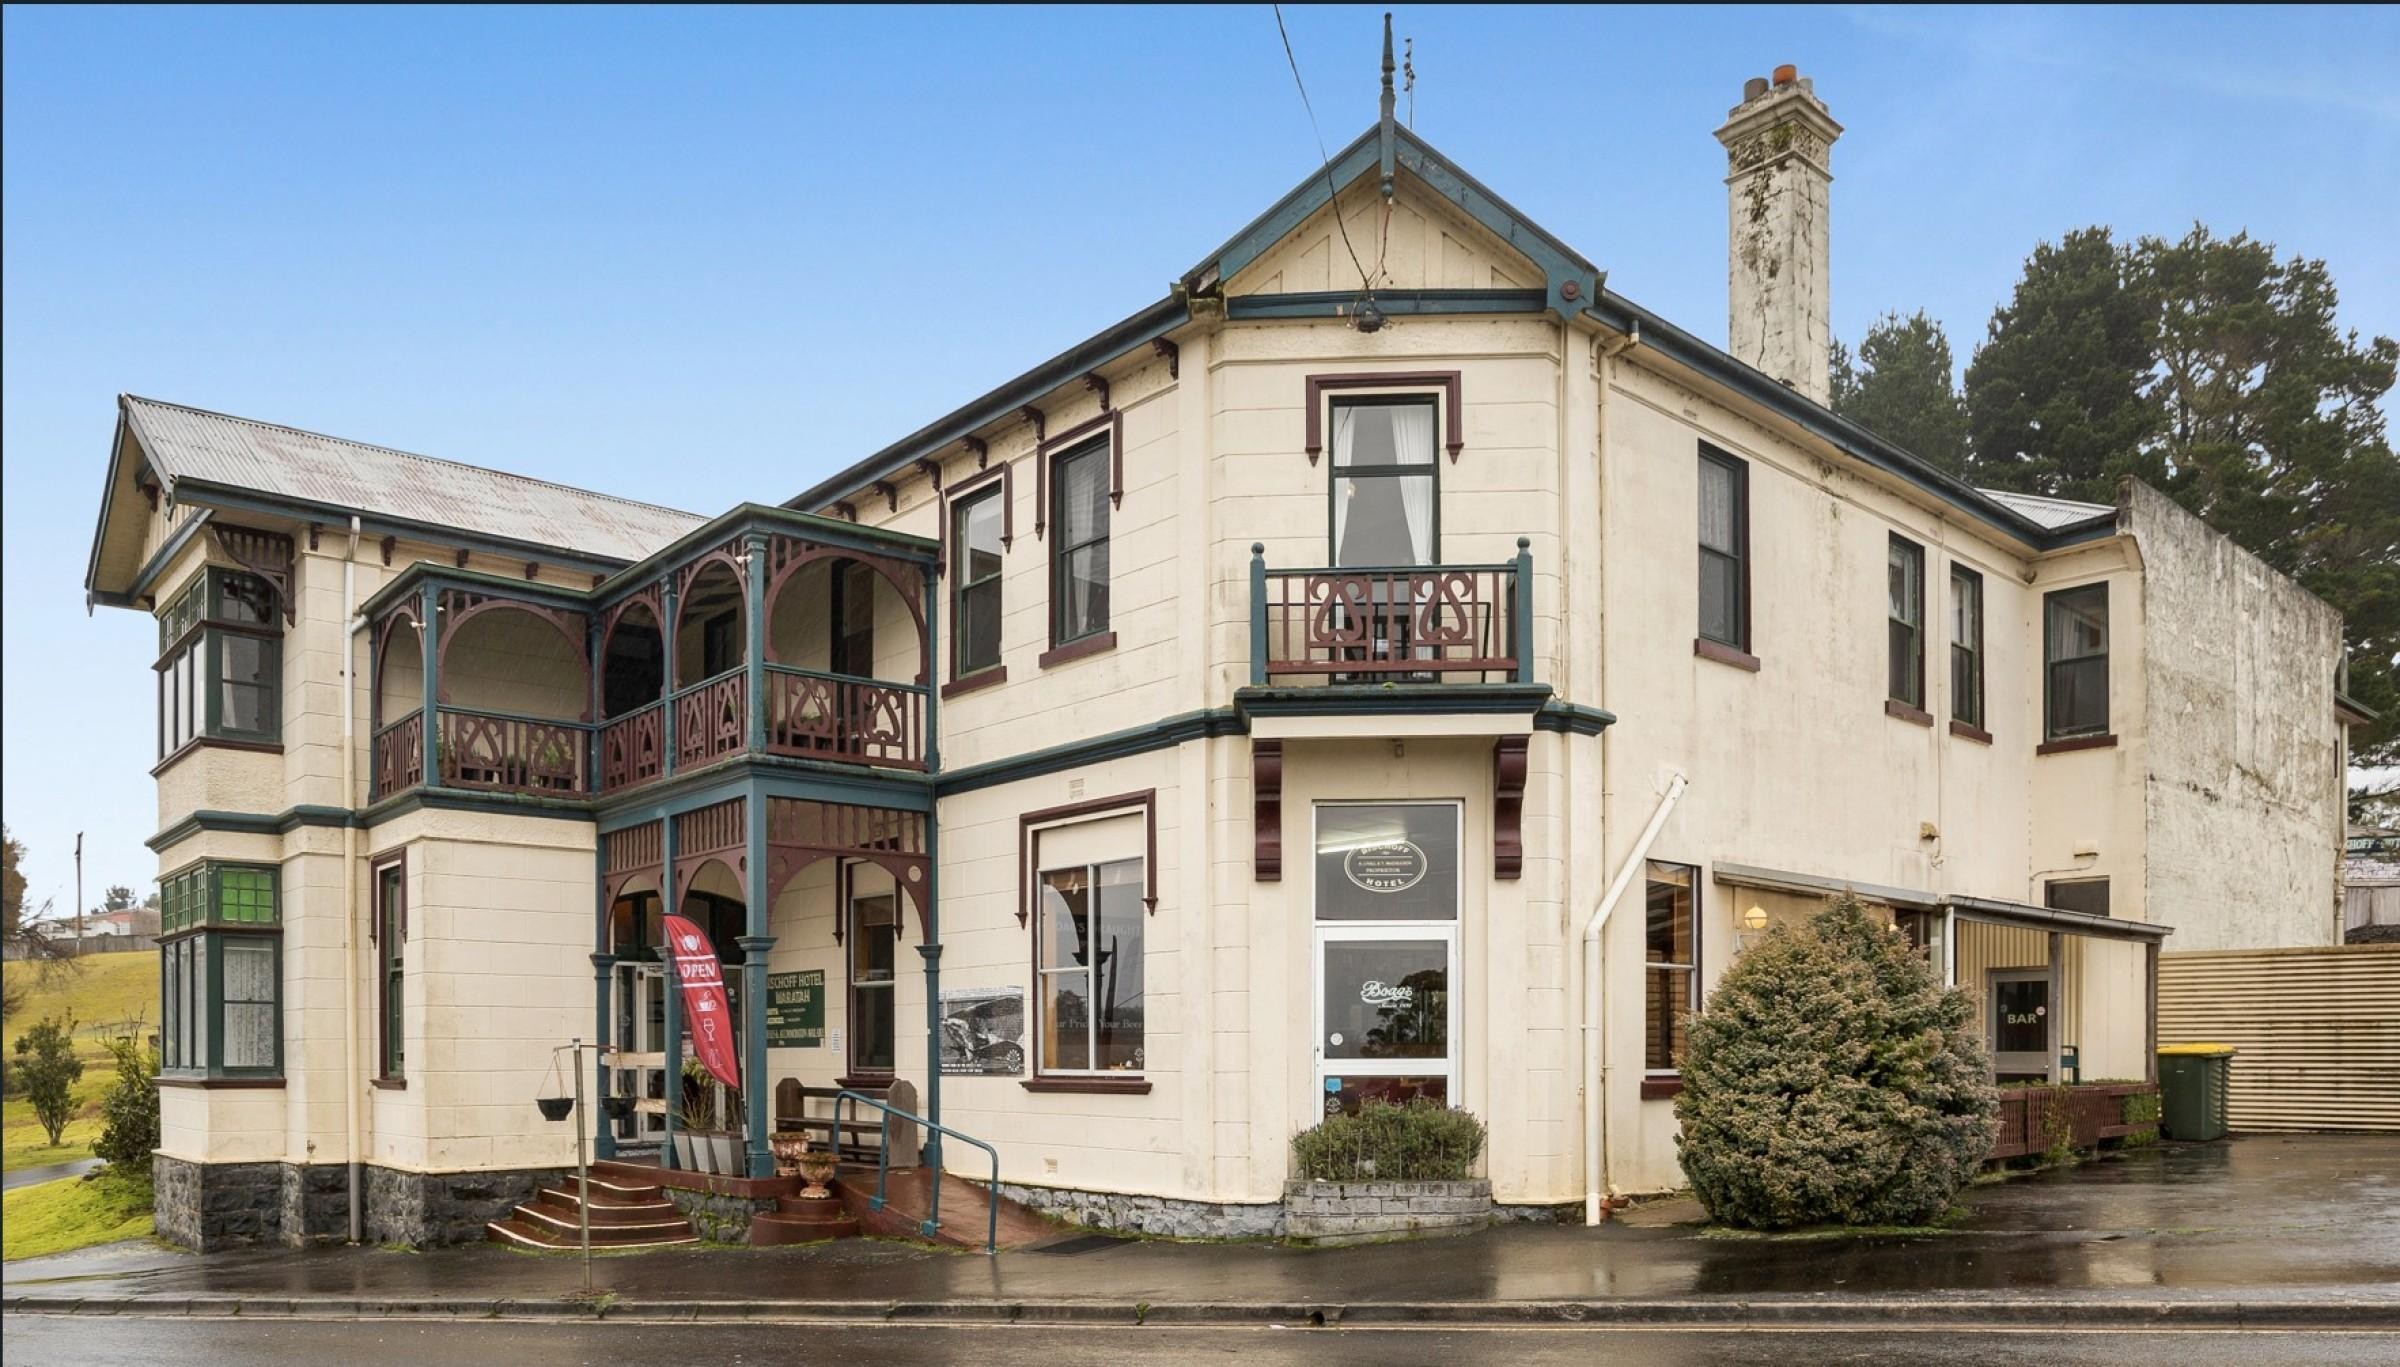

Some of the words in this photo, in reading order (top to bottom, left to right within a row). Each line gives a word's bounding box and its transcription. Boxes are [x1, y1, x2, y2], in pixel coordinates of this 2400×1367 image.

[1366, 877, 1405, 887] HOTEL
[682, 962, 715, 978] OPEN
[799, 973, 824, 987] HOTEL
[2007, 1013, 2037, 1024] BAR
